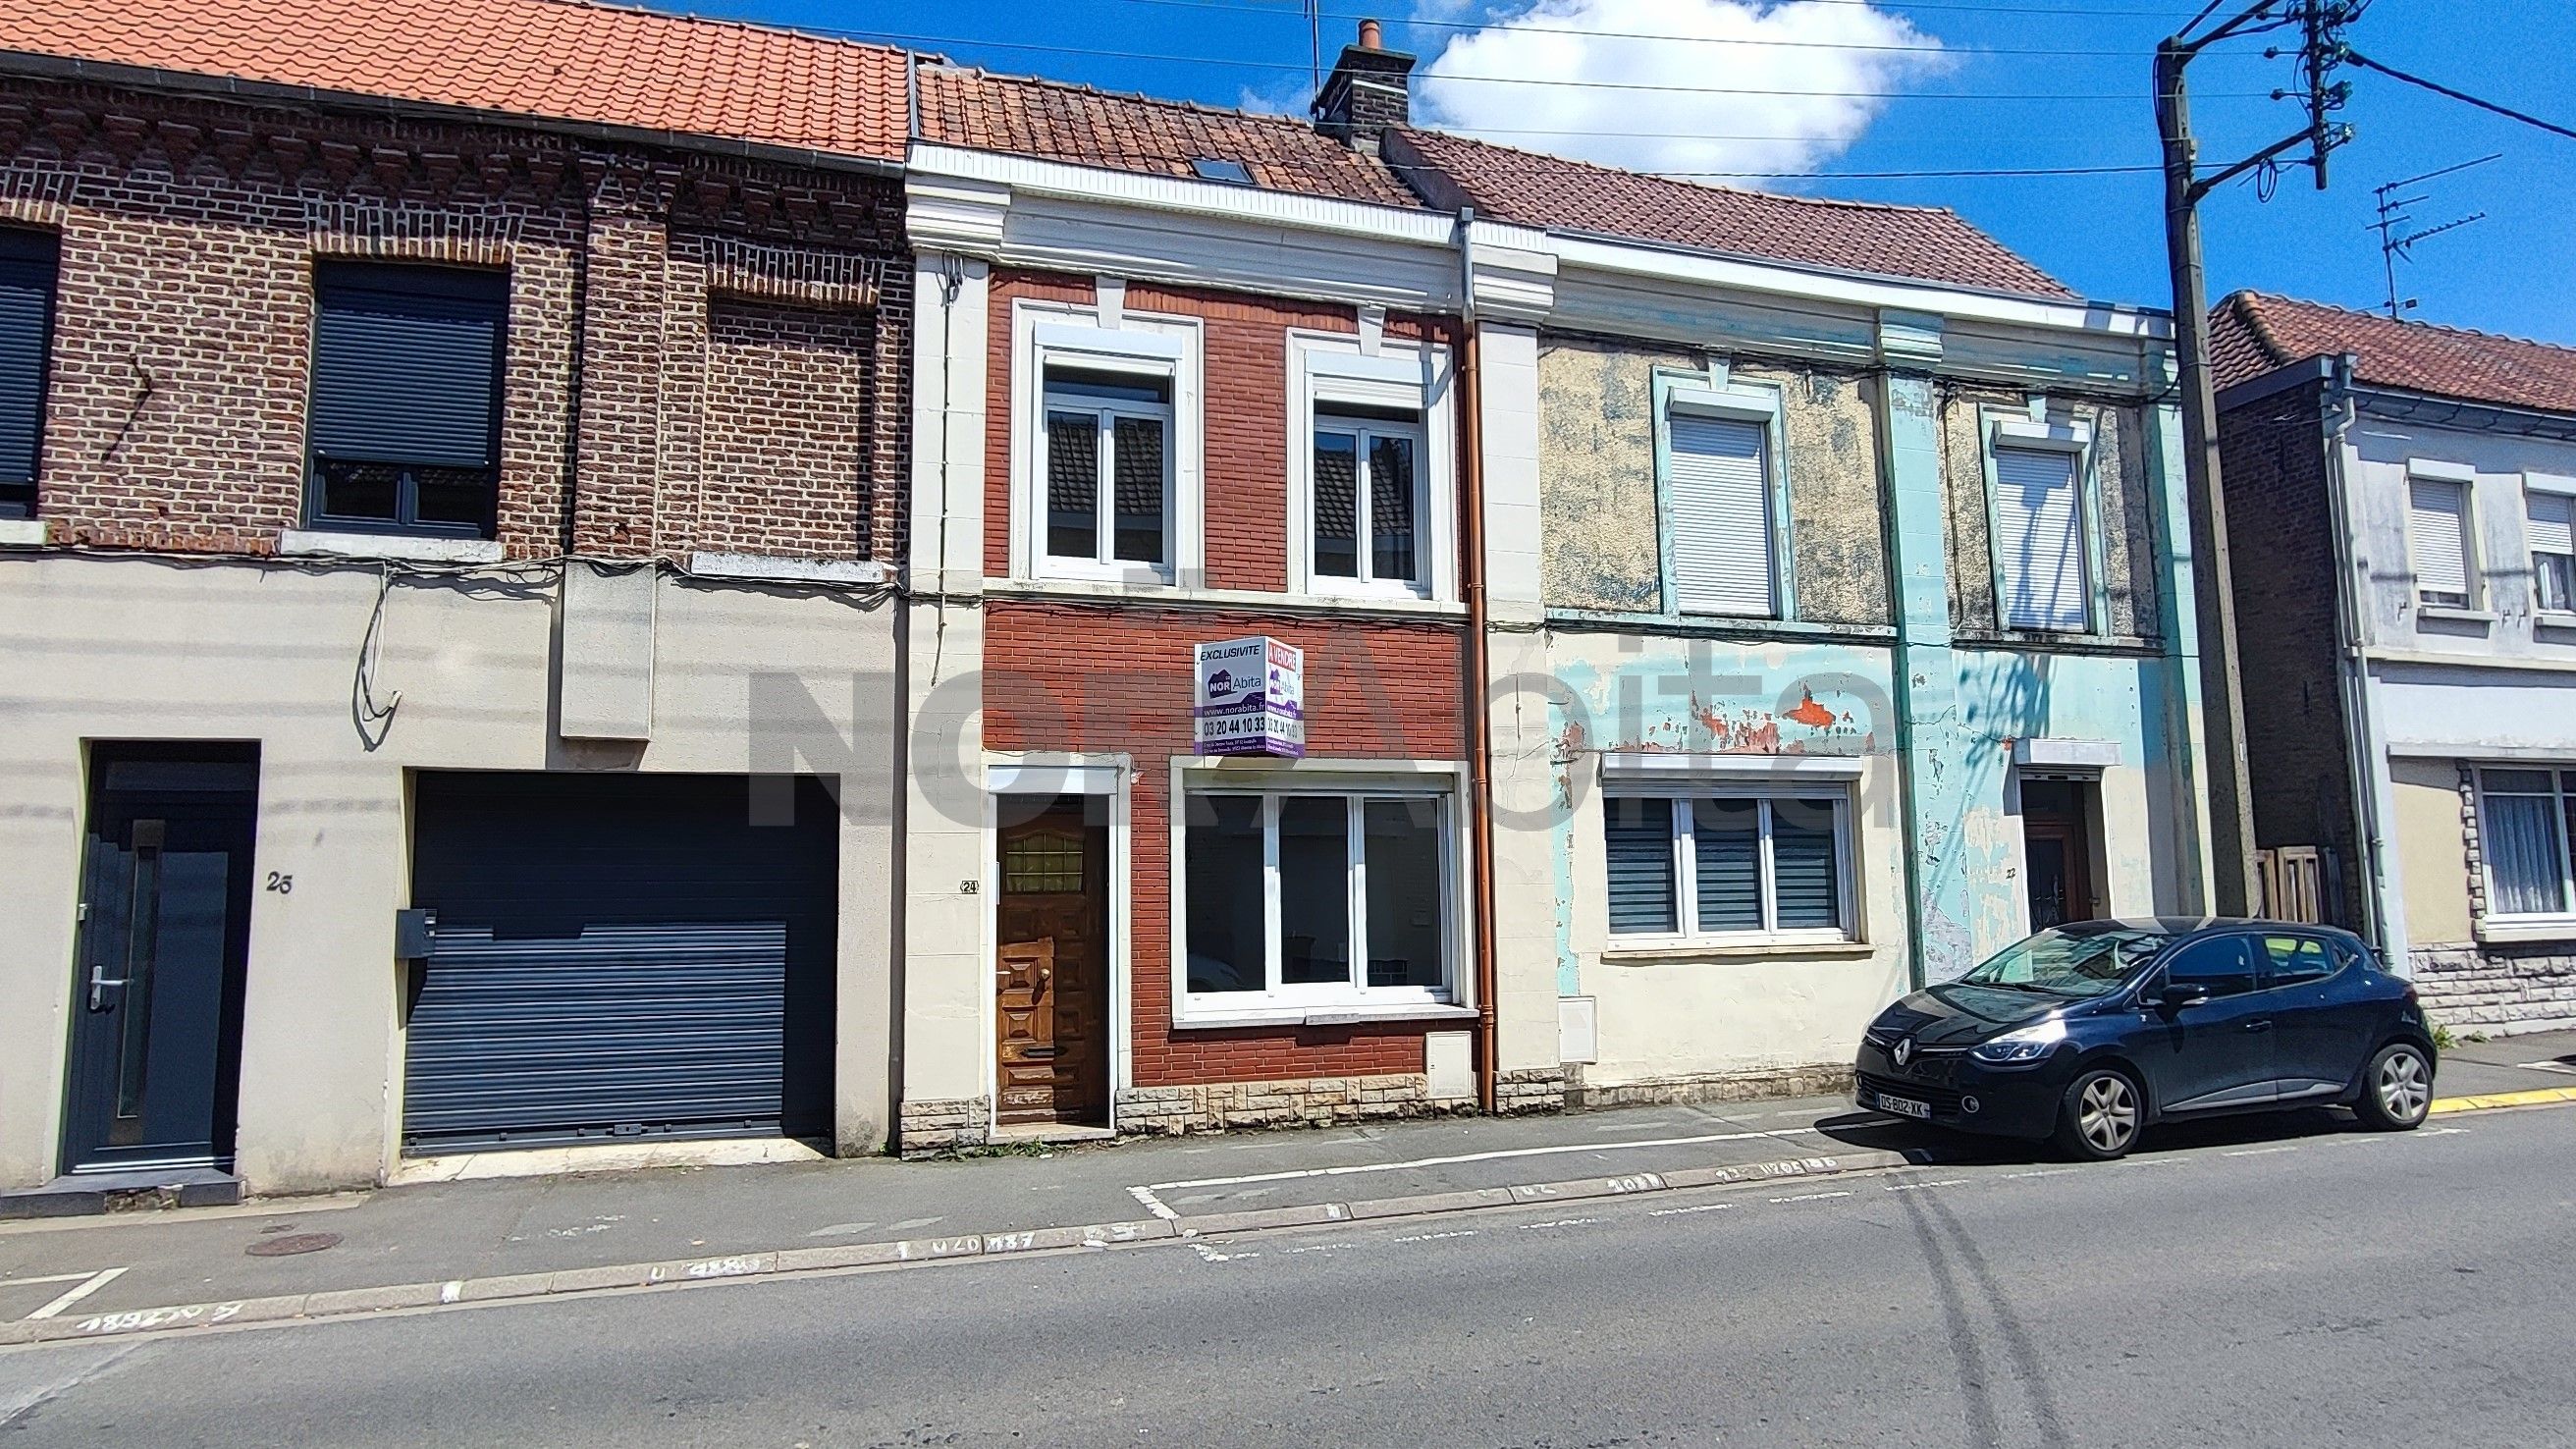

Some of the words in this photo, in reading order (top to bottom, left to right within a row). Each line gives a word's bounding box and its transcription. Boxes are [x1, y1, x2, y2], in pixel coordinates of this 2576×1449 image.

[1200, 645, 1261, 661] EXCLUSIVITE
[1273, 646, 1296, 670] VENDRE
[1204, 702, 1264, 716] www.norabita.fr
[1204, 722, 1214, 736] 03
[1217, 721, 1227, 735] 20
[1228, 719, 1240, 734] 44
[1243, 718, 1253, 733] 10
[1254, 717, 1265, 732] 33
[963, 882, 977, 892] 24
